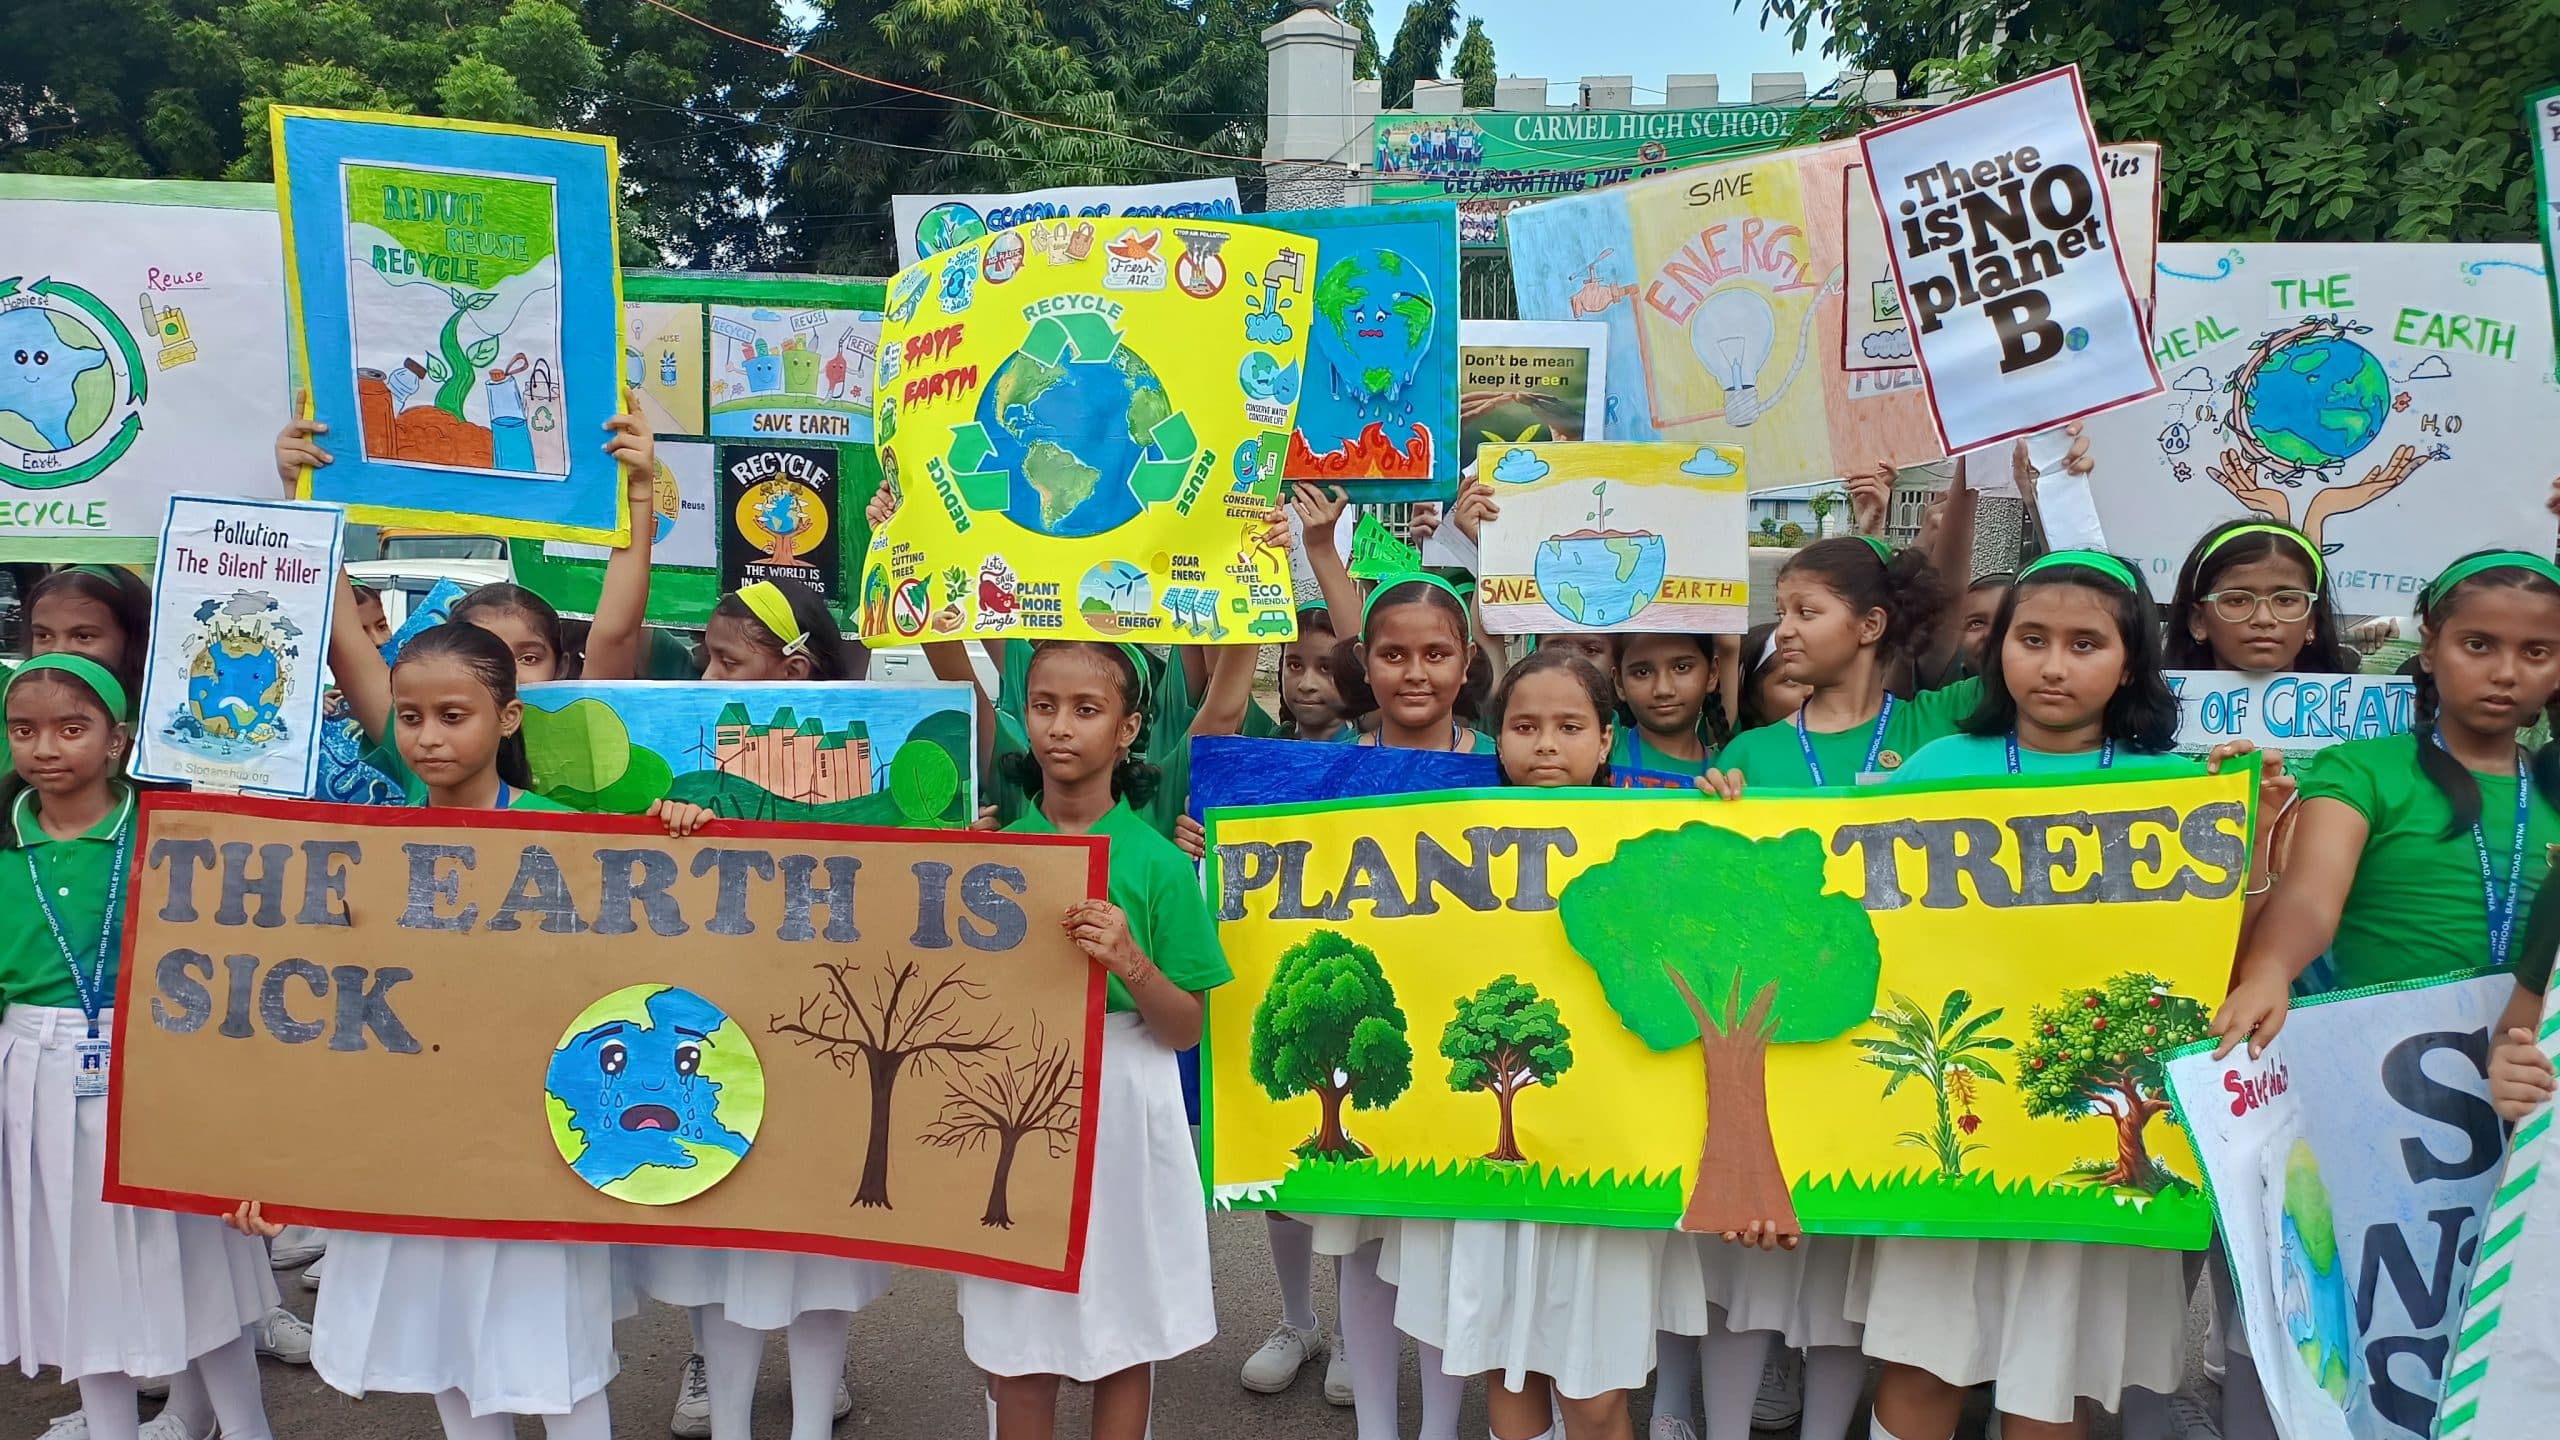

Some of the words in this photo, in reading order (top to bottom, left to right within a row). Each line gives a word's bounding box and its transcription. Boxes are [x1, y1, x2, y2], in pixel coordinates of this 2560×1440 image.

[1513, 115, 1613, 141] CARMEL
[1618, 112, 1685, 140] HIGH
[1690, 112, 1793, 138] SCHOOL
[1903, 145, 2042, 208] There
[1688, 173, 1755, 207] SAVE
[382, 184, 484, 227] REDUCE
[1899, 199, 1964, 259] is
[1960, 164, 2094, 258] NO
[445, 227, 530, 262] REUSE
[372, 244, 481, 286] RECYCLE
[1110, 258, 1155, 275] Fresh
[1644, 217, 1822, 326] ENERGY
[1908, 214, 2106, 335] planet
[148, 267, 204, 291] Reuse
[1126, 275, 1150, 287] AIR
[2270, 274, 2356, 310] THE
[793, 311, 825, 328] REUSE
[1022, 294, 1124, 321] RECYCLE
[712, 319, 754, 343] RECYCLE
[2153, 314, 2241, 369] HEAL
[2393, 307, 2518, 361] EARTH
[904, 323, 965, 371] SAVE
[1465, 353, 1507, 368] Don't
[1510, 353, 1529, 368] be
[1532, 356, 1576, 369] mean
[903, 365, 978, 411] EARTH
[1468, 372, 1506, 388] keep
[1509, 372, 1521, 386] it
[1524, 375, 1570, 389] green
[1853, 369, 1923, 393] FUEL
[752, 413, 793, 433] SAVE
[799, 414, 850, 436] EARTH
[730, 451, 830, 491] RECYCLE
[1175, 449, 1217, 517] REUSE
[681, 499, 706, 511] Reuse
[924, 455, 973, 535] REDUCE
[1223, 493, 1265, 507] CONSERVE
[213, 518, 289, 549] Pollution
[891, 541, 910, 556] STOP
[891, 551, 925, 567] CUTTING
[1171, 554, 1200, 568] SOLAR
[176, 547, 209, 576] The
[217, 552, 268, 580] Silent
[274, 557, 322, 585] Killer
[744, 564, 767, 577] THE
[768, 566, 807, 580] WORLD
[809, 568, 821, 580] IS
[891, 564, 915, 580] TREES
[995, 572, 1016, 585] SAVE
[1171, 569, 1206, 582] ENERGY
[1225, 564, 1259, 575] CLEAN
[1236, 574, 1262, 584] FUEL
[1016, 582, 1061, 596] PLANT
[1249, 583, 1282, 598] ECO
[1251, 597, 1291, 607] FRIENDLY
[1480, 578, 1536, 605] SAVE
[1660, 579, 1734, 600] EARTH
[1021, 598, 1062, 612] MORE
[974, 610, 1017, 632] Jungle
[1021, 614, 1063, 628] TREES
[1117, 616, 1162, 629] ENERGY
[2201, 687, 2250, 735] OF
[1215, 826, 1580, 923] PLANT
[1832, 801, 2247, 911] TREES
[2503, 878, 2518, 915] BAILEY
[2513, 822, 2525, 850] PATNA
[109, 870, 120, 899] BAILEY
[149, 837, 362, 928] THE
[400, 841, 862, 944] EARTH
[910, 860, 1029, 952] IS
[2485, 881, 2496, 911] PATNA
[57, 936, 74, 962] BAILEY
[98, 936, 109, 958] HIGH
[93, 958, 105, 993] CARMEL
[2223, 1069, 2269, 1118] Save
